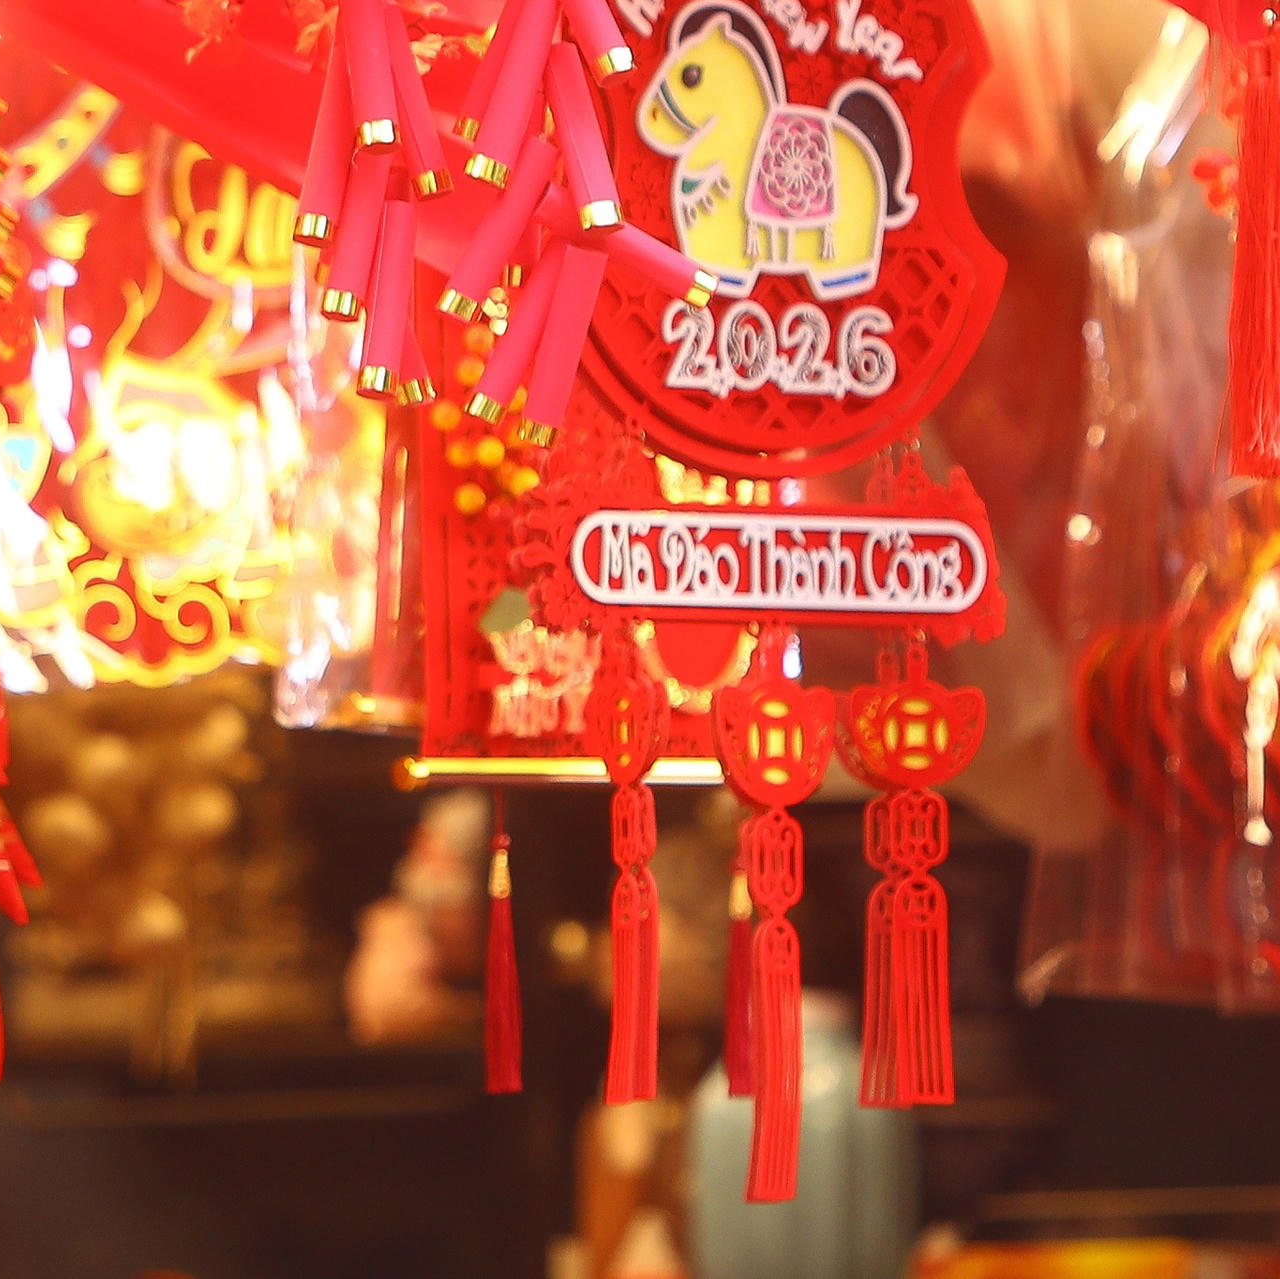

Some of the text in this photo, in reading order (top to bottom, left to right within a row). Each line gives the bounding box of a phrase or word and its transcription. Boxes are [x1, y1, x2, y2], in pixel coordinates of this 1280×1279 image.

[663, 298, 897, 399] 2026
[740, 525, 857, 599] Thành
[861, 529, 963, 602] Công
